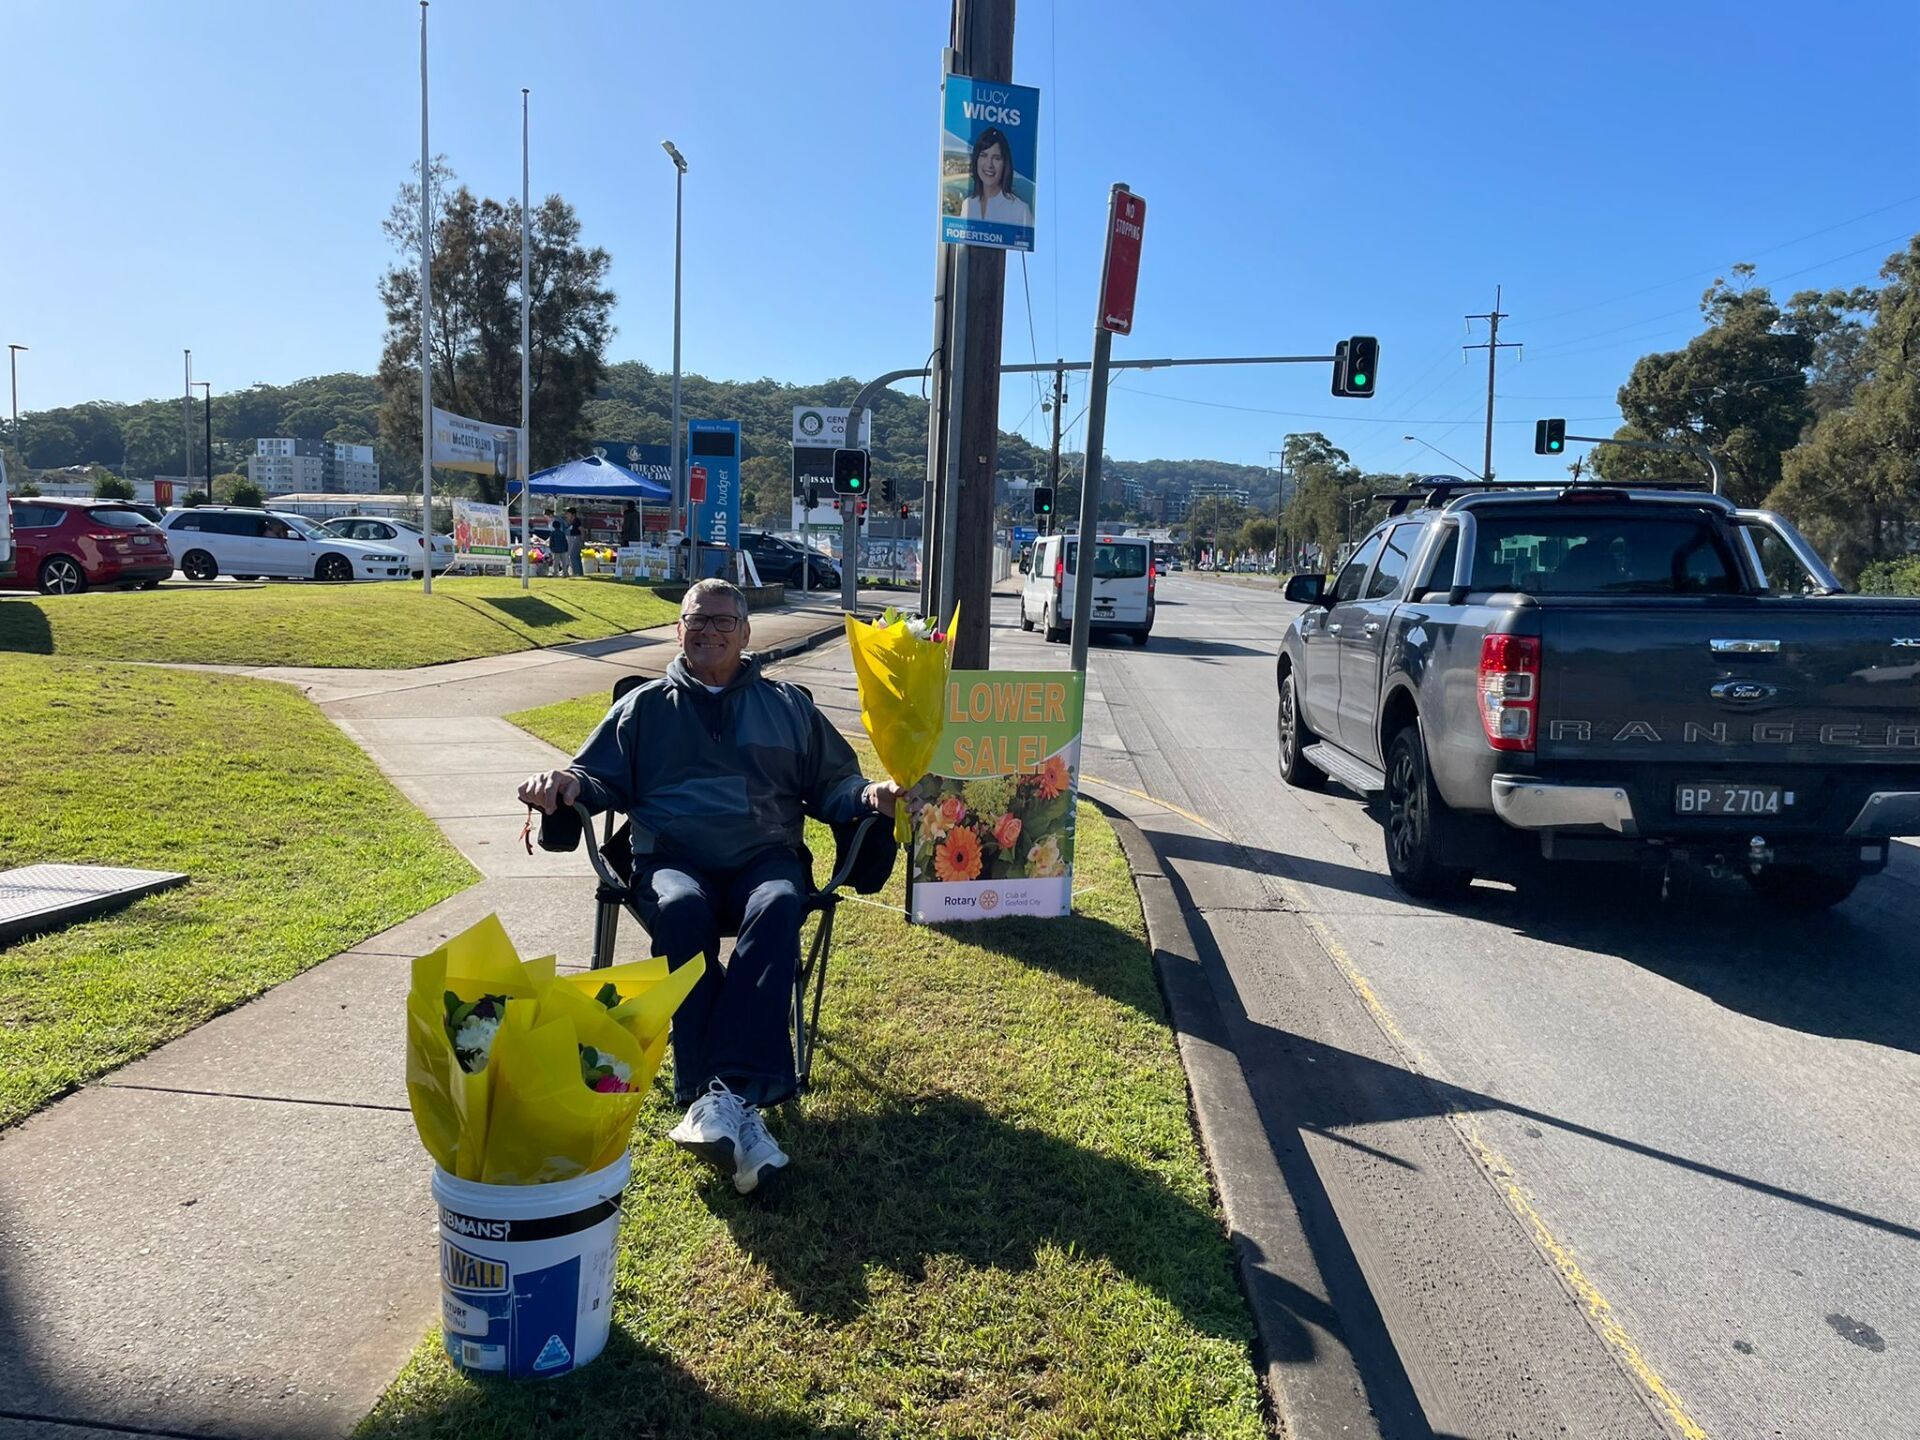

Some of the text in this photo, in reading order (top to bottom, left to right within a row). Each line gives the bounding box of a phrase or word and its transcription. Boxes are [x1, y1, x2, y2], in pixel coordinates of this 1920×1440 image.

[976, 87, 1009, 105] LUCY
[963, 101, 1021, 126] WICKS
[1125, 201, 1135, 219] NO
[946, 227, 1003, 243] ROBERTSON
[1115, 218, 1140, 241] STOPPING
[629, 463, 672, 474] THE COAS
[711, 469, 731, 540] ibis budget
[948, 682, 1066, 723] LOWER
[1732, 685, 1762, 697] Ford
[1549, 720, 1920, 747] RANGER
[952, 735, 1048, 775] SALE!
[1681, 788, 1778, 812] BP 2704
[944, 896, 977, 907] Rotary
[1029, 898, 1041, 906] City
[441, 1209, 504, 1239] UBMANS
